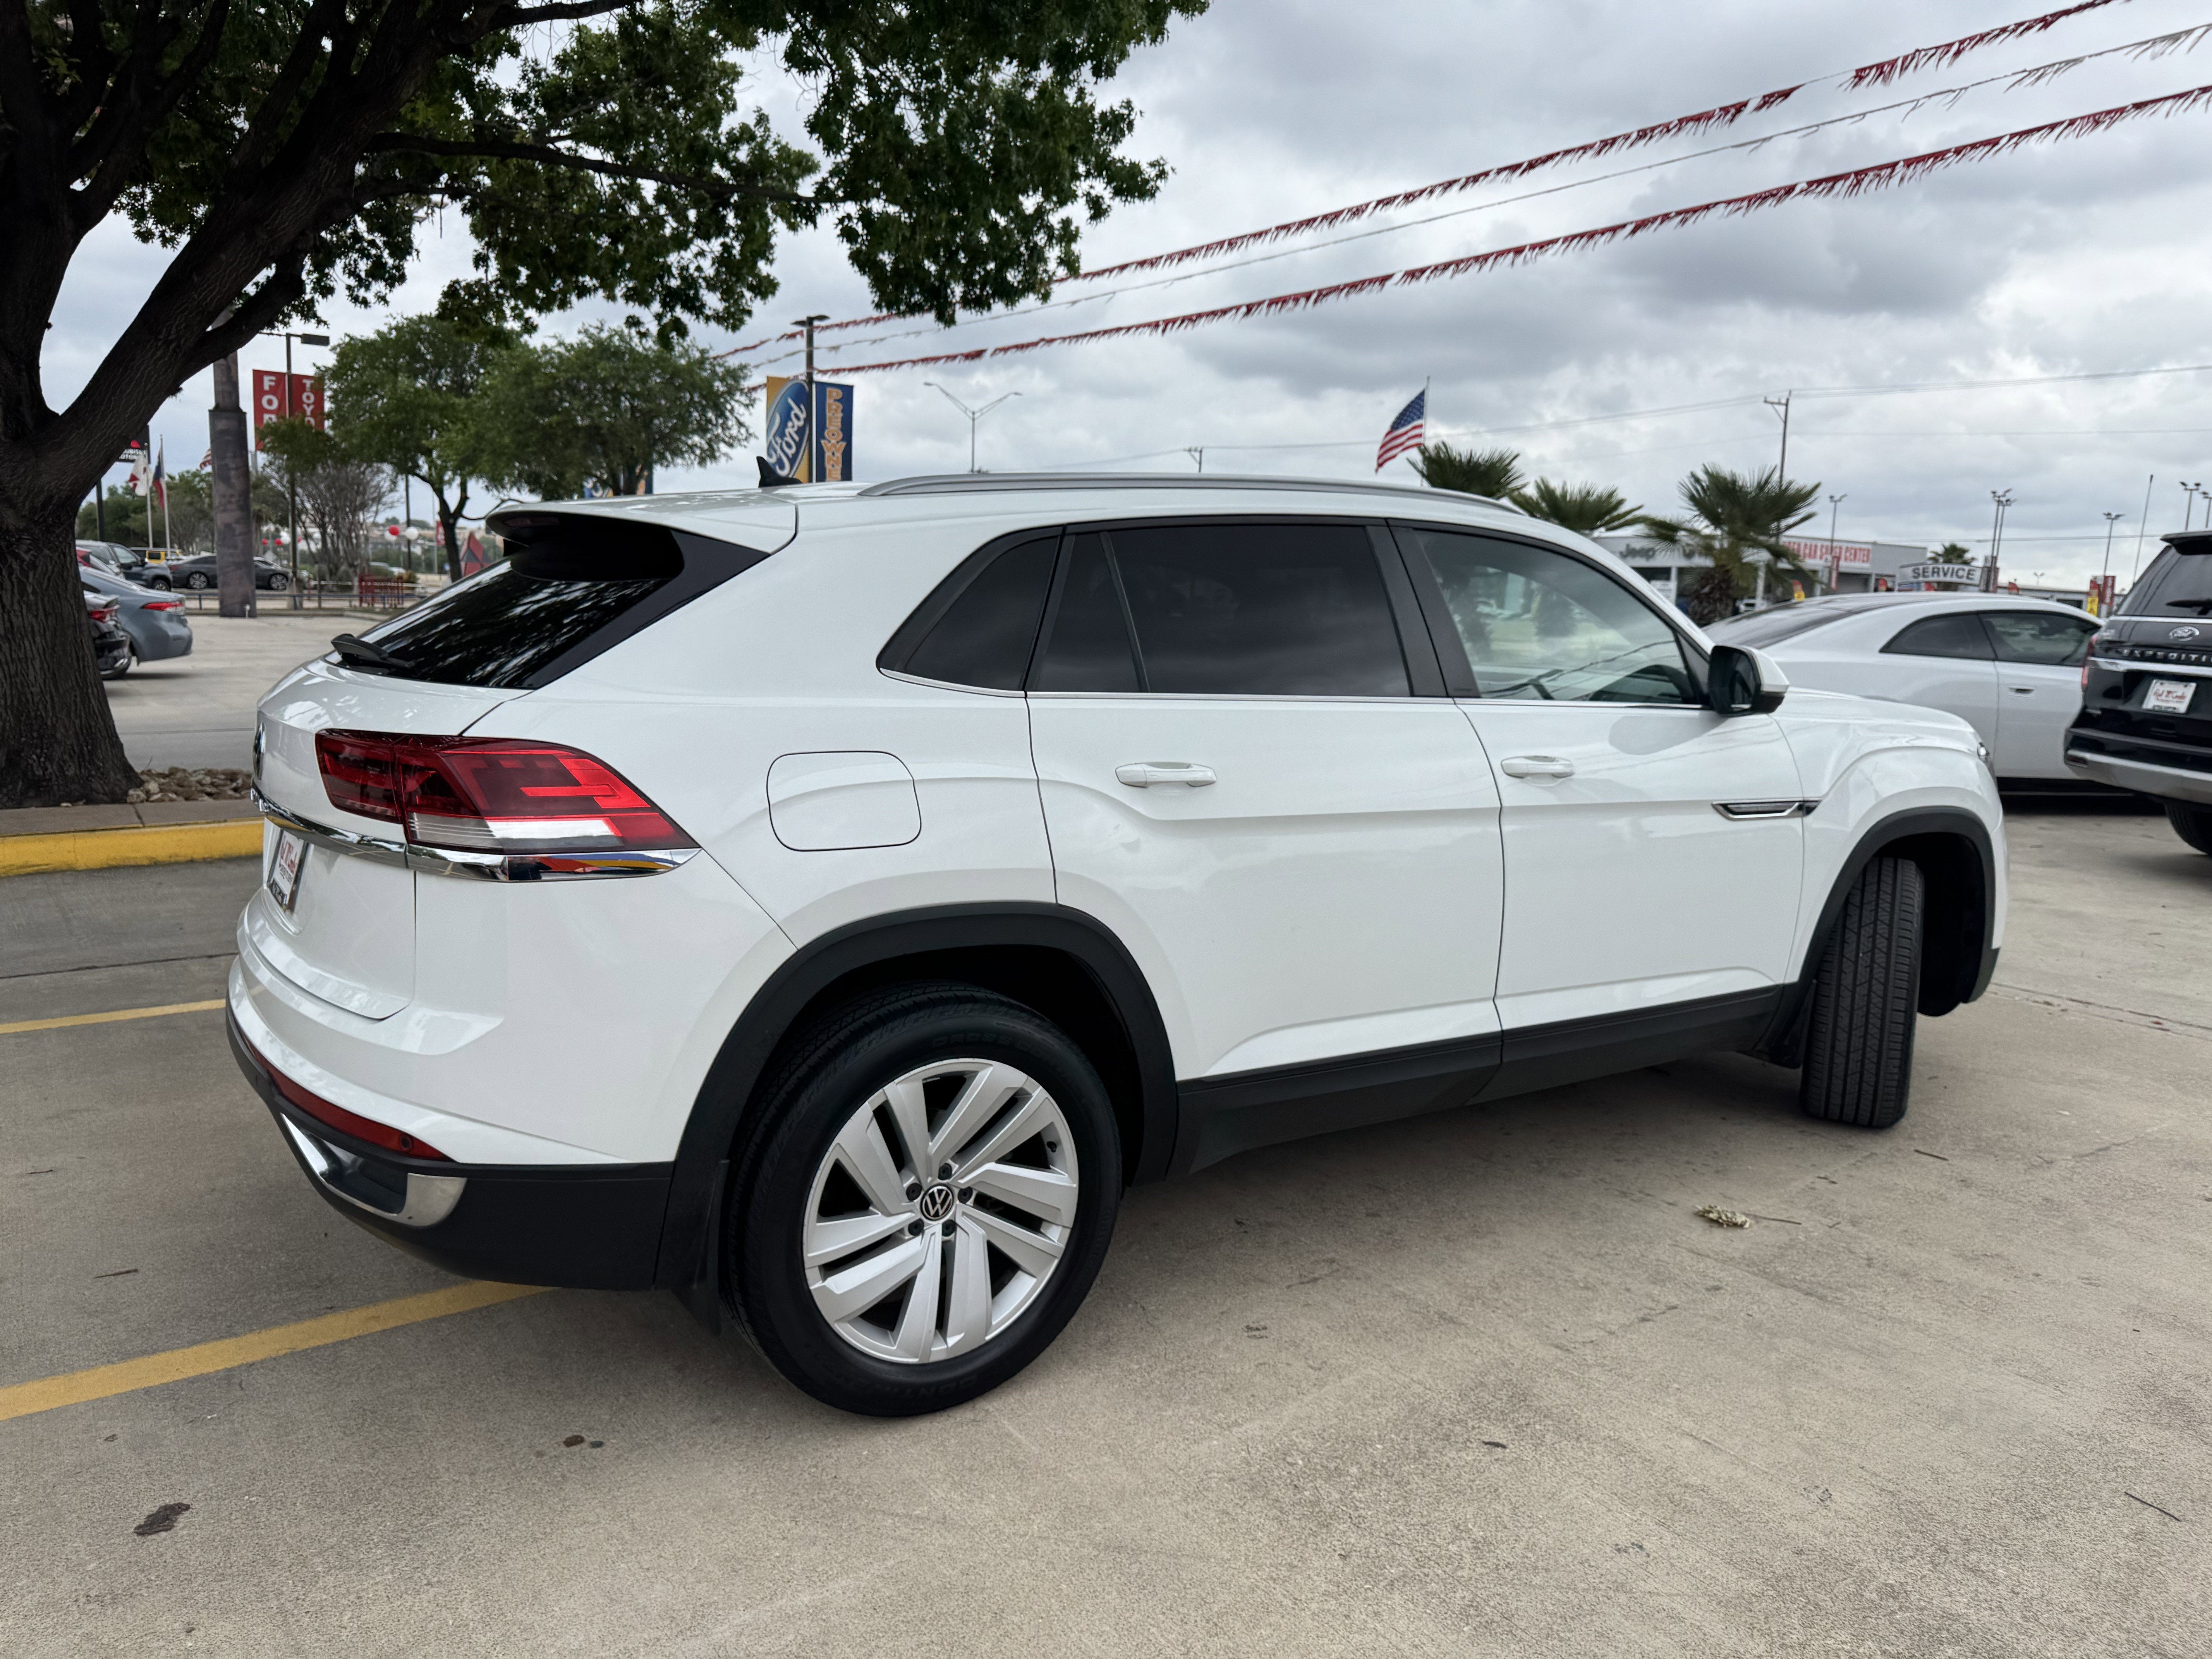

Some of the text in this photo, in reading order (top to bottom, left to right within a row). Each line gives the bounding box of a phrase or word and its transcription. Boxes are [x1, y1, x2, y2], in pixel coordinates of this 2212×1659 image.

[768, 397, 807, 477] Ford
[1912, 566, 1976, 580] SERVICE
[2123, 649, 2212, 662] EXPEDITI
[922, 1186, 953, 1219] VW
